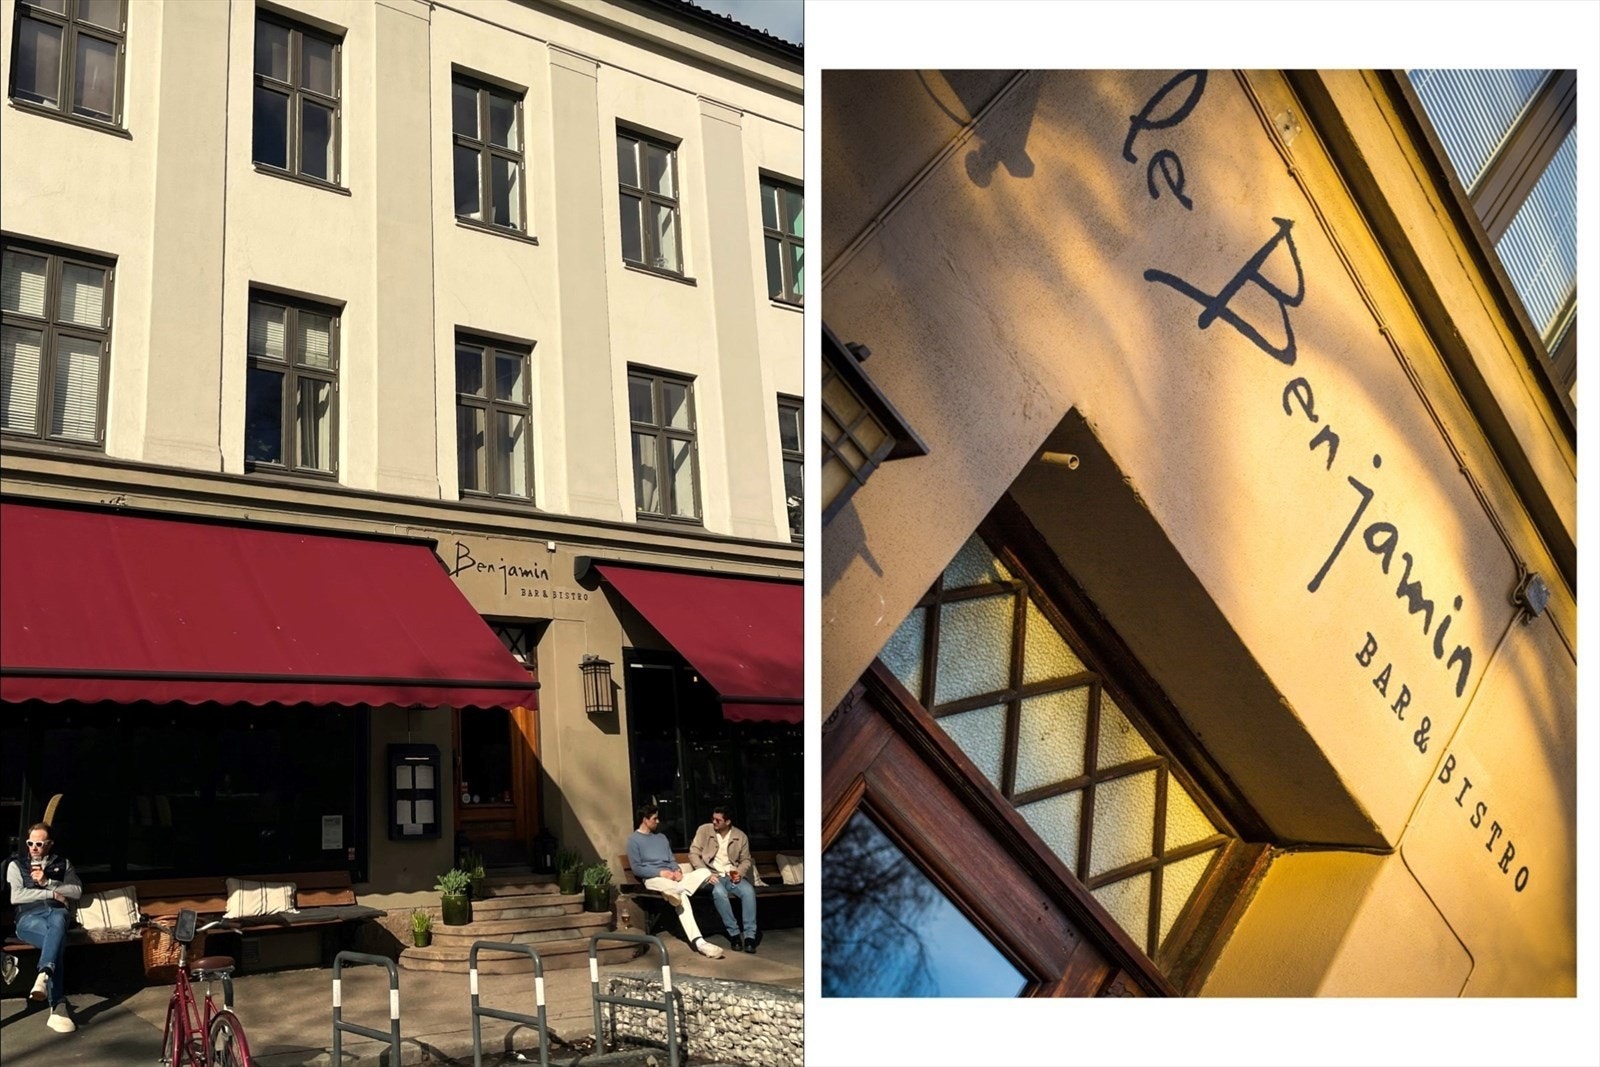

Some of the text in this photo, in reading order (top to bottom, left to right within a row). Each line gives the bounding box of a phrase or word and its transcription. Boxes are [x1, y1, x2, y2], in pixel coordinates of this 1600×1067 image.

[1143, 216, 1473, 698] Benjamin
[449, 541, 549, 595] Benjamin
[520, 588, 540, 598] BAR
[552, 590, 589, 601] BISTRO
[1355, 631, 1530, 893] BAR & BISTRO
